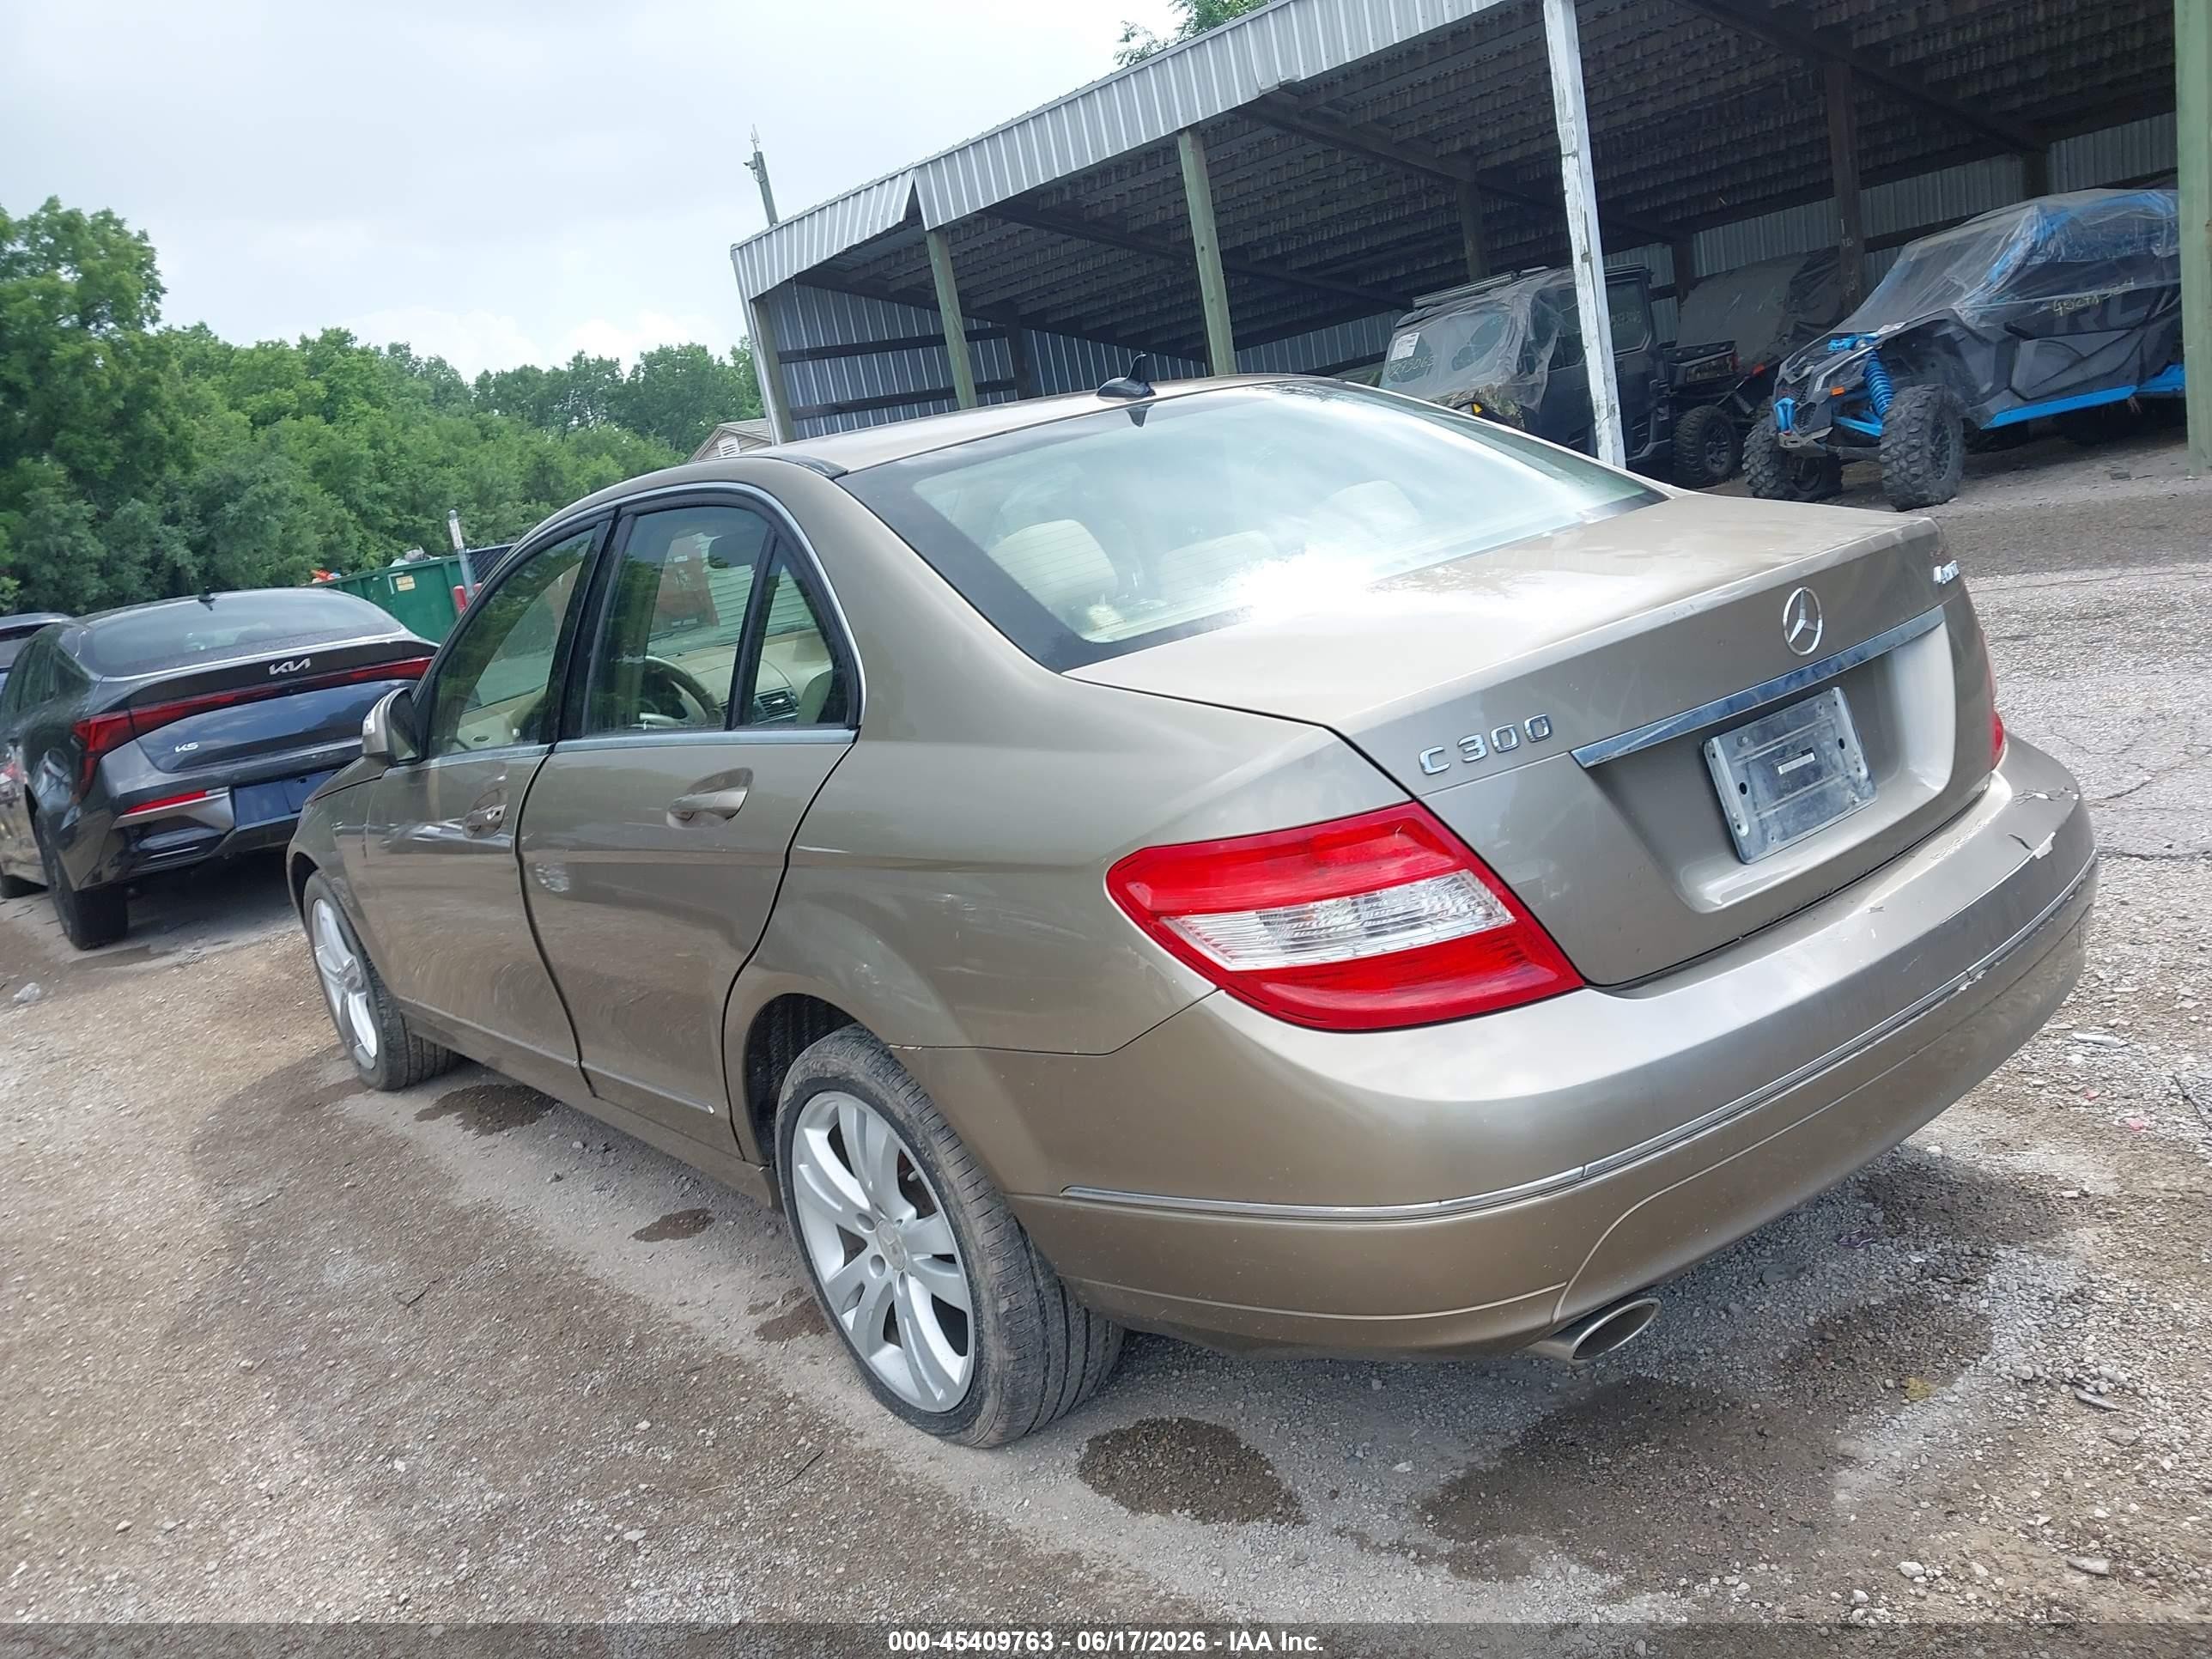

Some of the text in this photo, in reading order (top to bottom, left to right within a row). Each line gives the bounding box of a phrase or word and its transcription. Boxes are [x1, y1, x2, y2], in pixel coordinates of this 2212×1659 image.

[268, 657, 312, 676] KIA
[174, 741, 199, 753] K5
[1419, 713, 1553, 775] C 300
